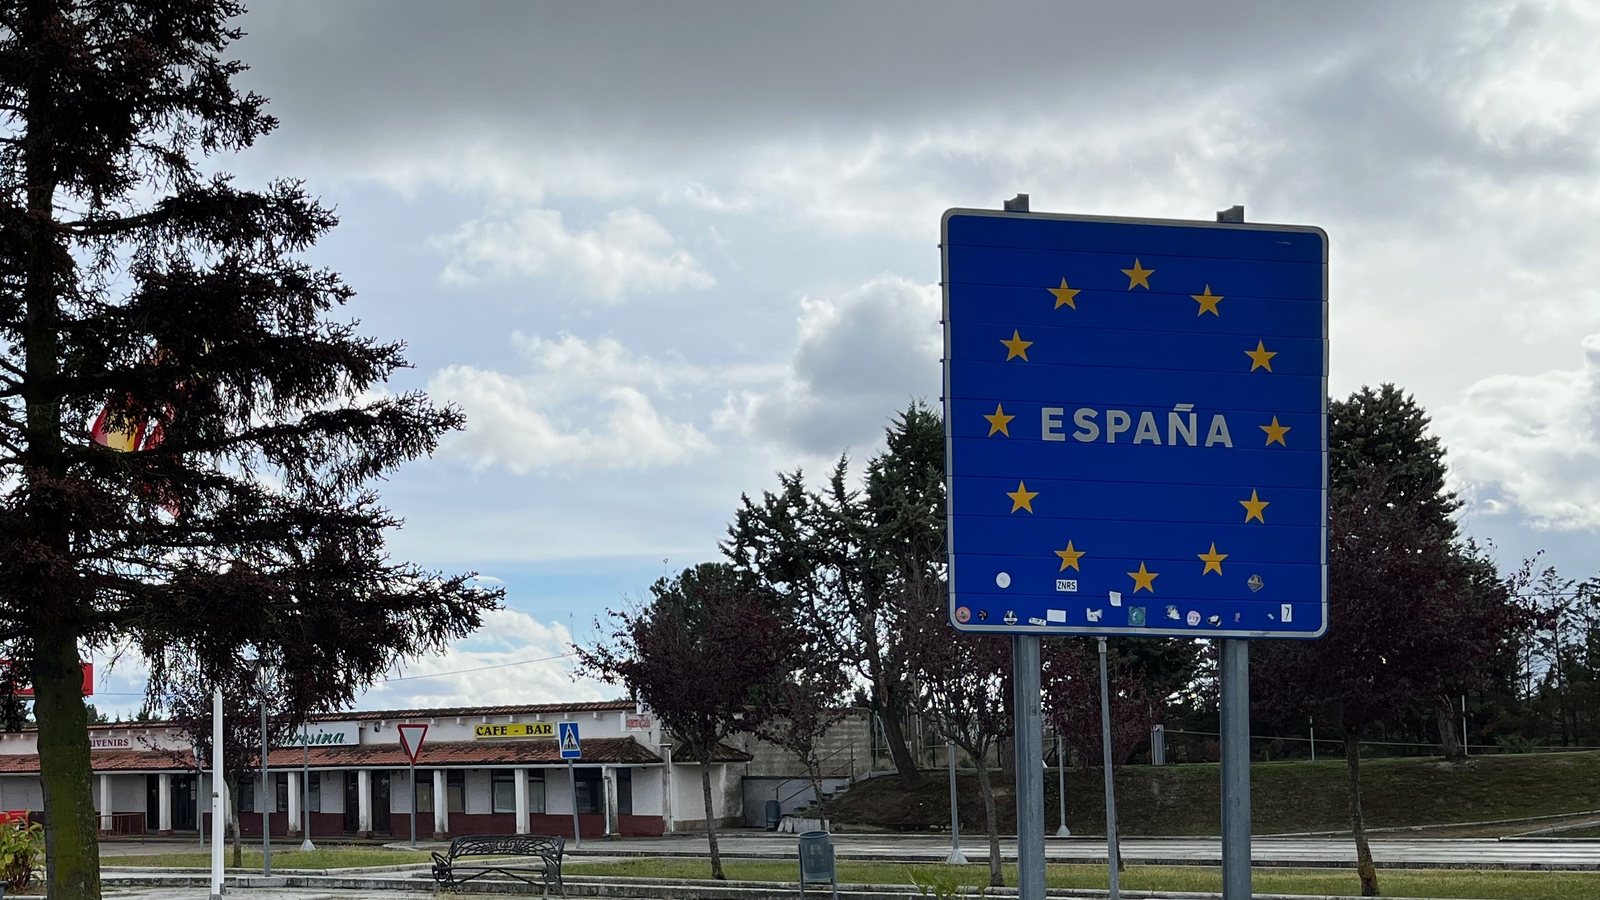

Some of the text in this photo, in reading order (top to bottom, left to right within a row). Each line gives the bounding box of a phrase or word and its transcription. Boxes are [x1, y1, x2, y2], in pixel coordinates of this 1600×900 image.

[1041, 403, 1233, 448] ESPAÑA
[1057, 581, 1076, 590] ZNRS
[476, 726, 508, 736] CAFE
[525, 725, 552, 735] BAR
